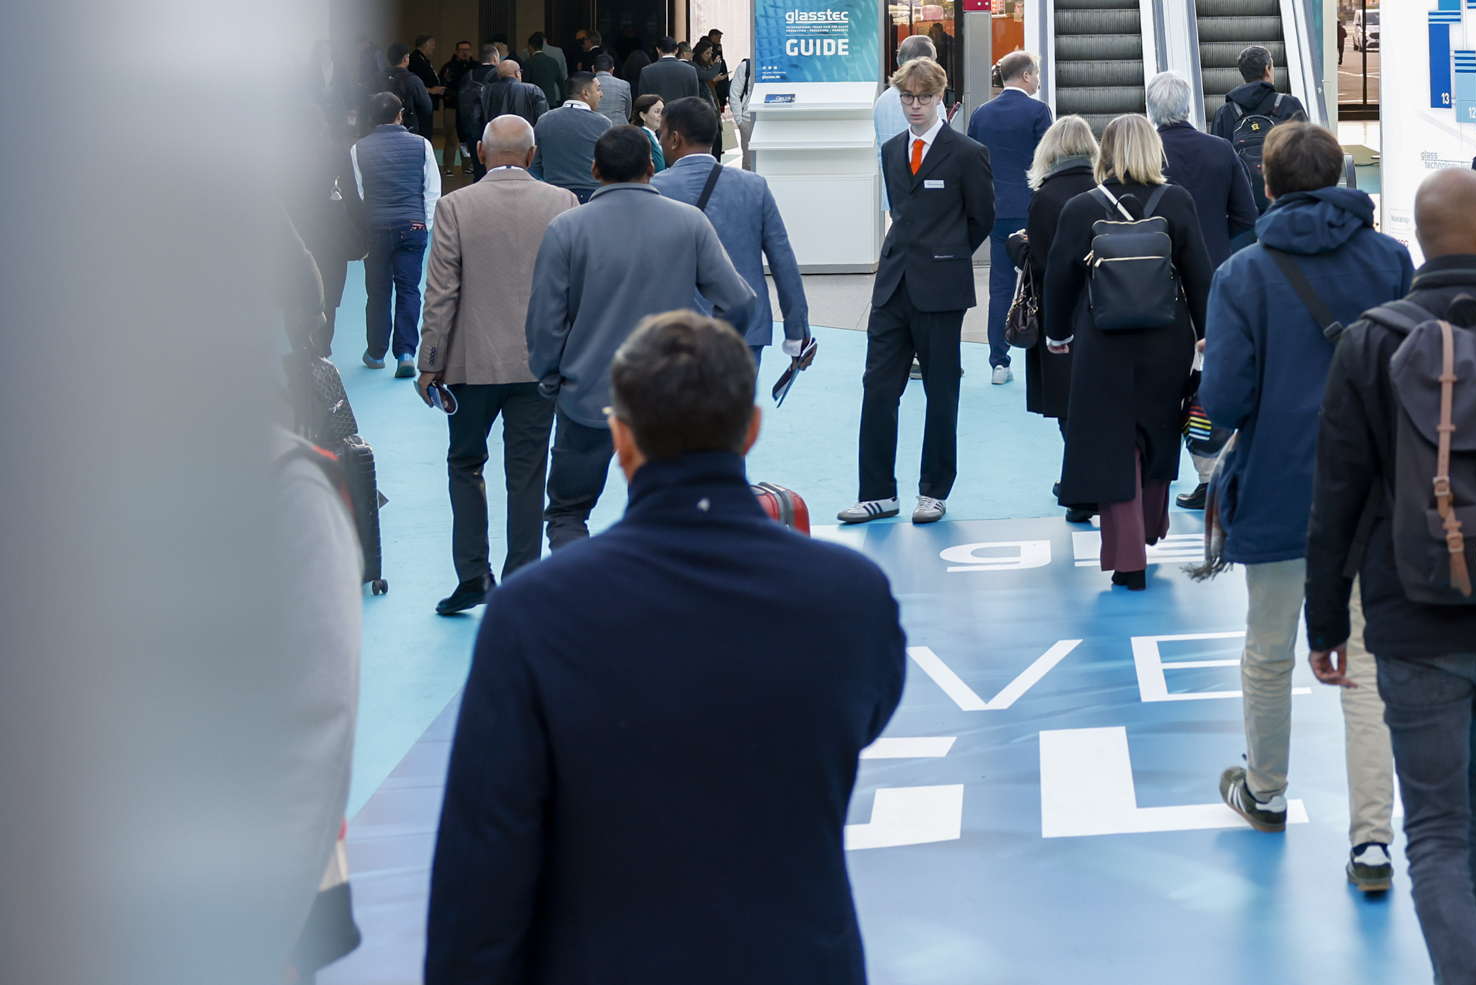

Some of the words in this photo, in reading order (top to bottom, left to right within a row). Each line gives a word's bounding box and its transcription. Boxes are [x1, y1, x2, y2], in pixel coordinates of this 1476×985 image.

[785, 9, 849, 24] glasstec
[785, 39, 849, 56] GUIDE
[1441, 92, 1449, 104] 13
[1468, 107, 1476, 119] 12
[1421, 150, 1438, 160] glass
